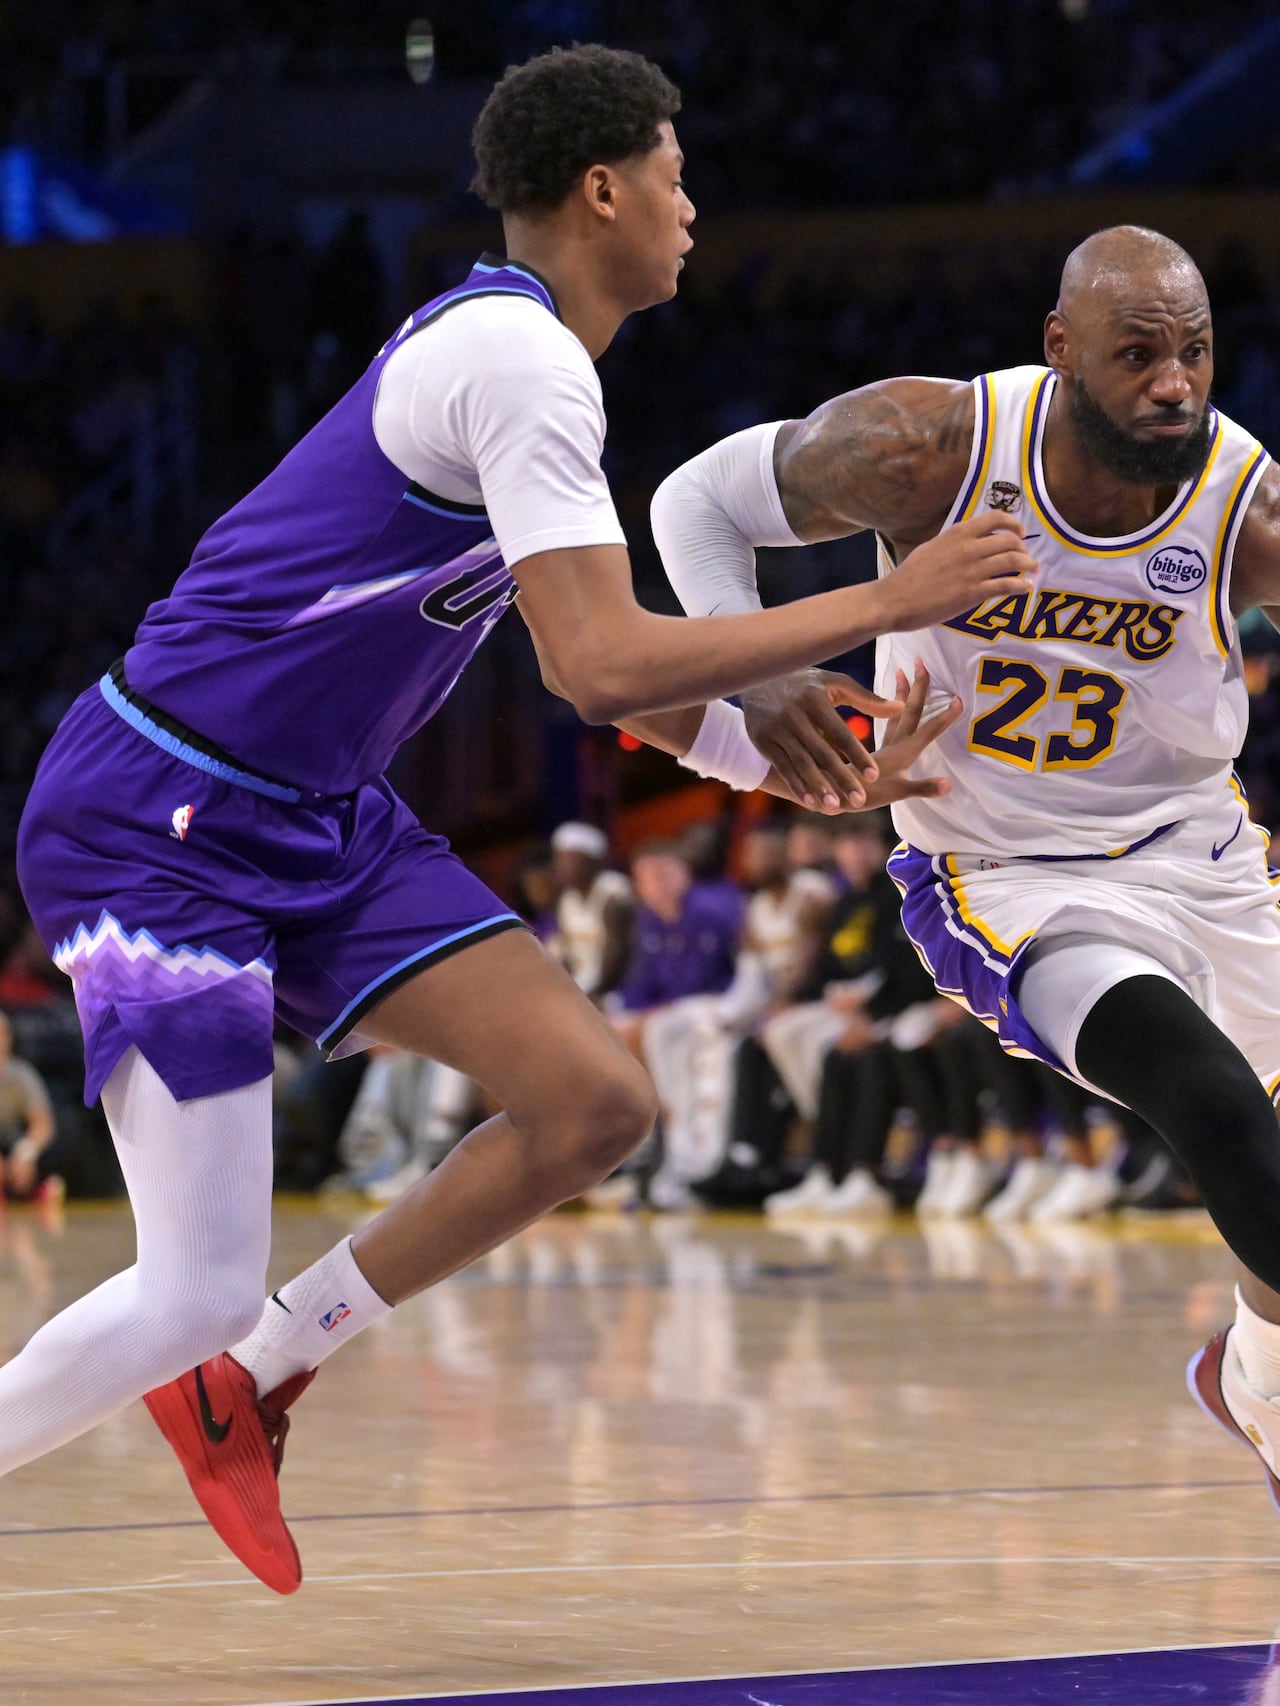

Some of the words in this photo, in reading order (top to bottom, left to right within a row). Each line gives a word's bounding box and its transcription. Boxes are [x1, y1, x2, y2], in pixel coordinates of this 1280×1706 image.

[1152, 556, 1203, 582] bibigo
[1157, 573, 1179, 584] 비비고
[967, 655, 1129, 773] 23
